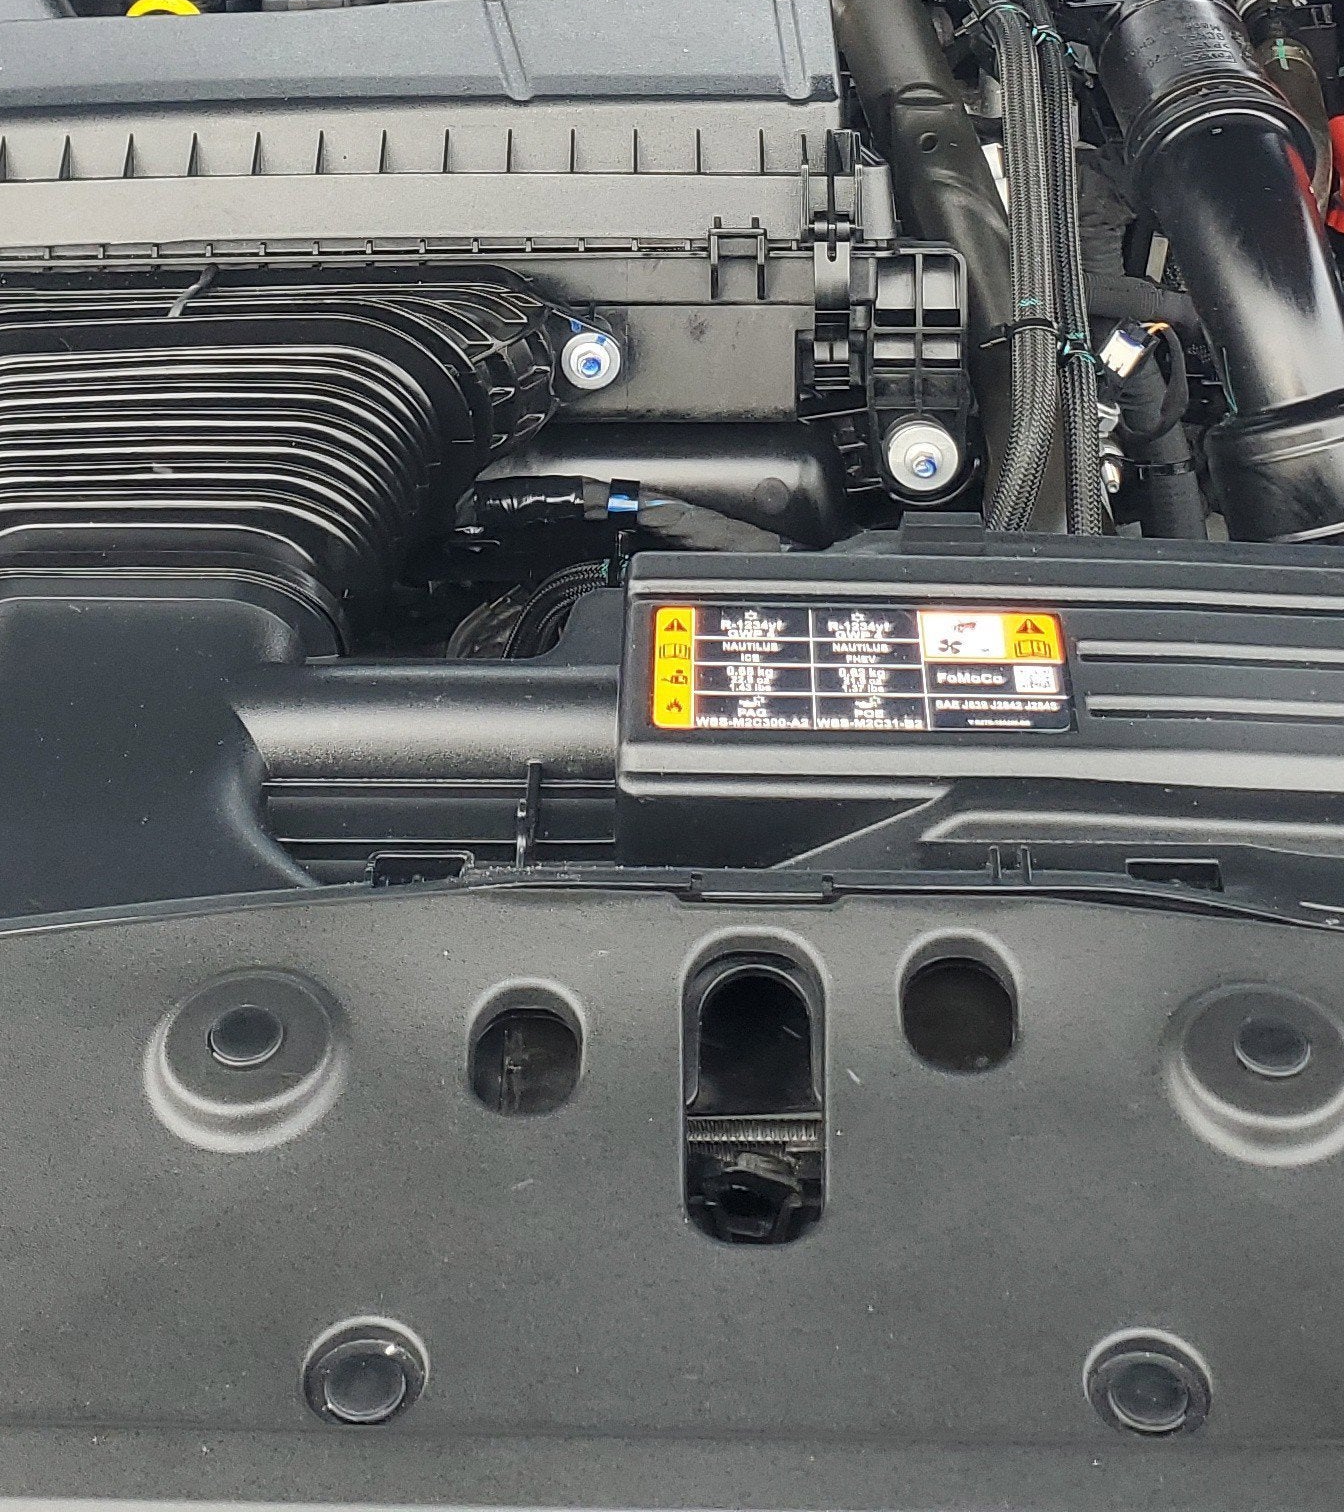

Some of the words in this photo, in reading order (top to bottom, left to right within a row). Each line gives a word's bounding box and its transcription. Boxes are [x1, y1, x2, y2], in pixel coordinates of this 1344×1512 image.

[722, 642, 780, 652] NAUTILUS
[832, 643, 891, 653] NAUTILUS
[757, 667, 774, 679] kg
[937, 672, 1004, 684] FoMoCo
